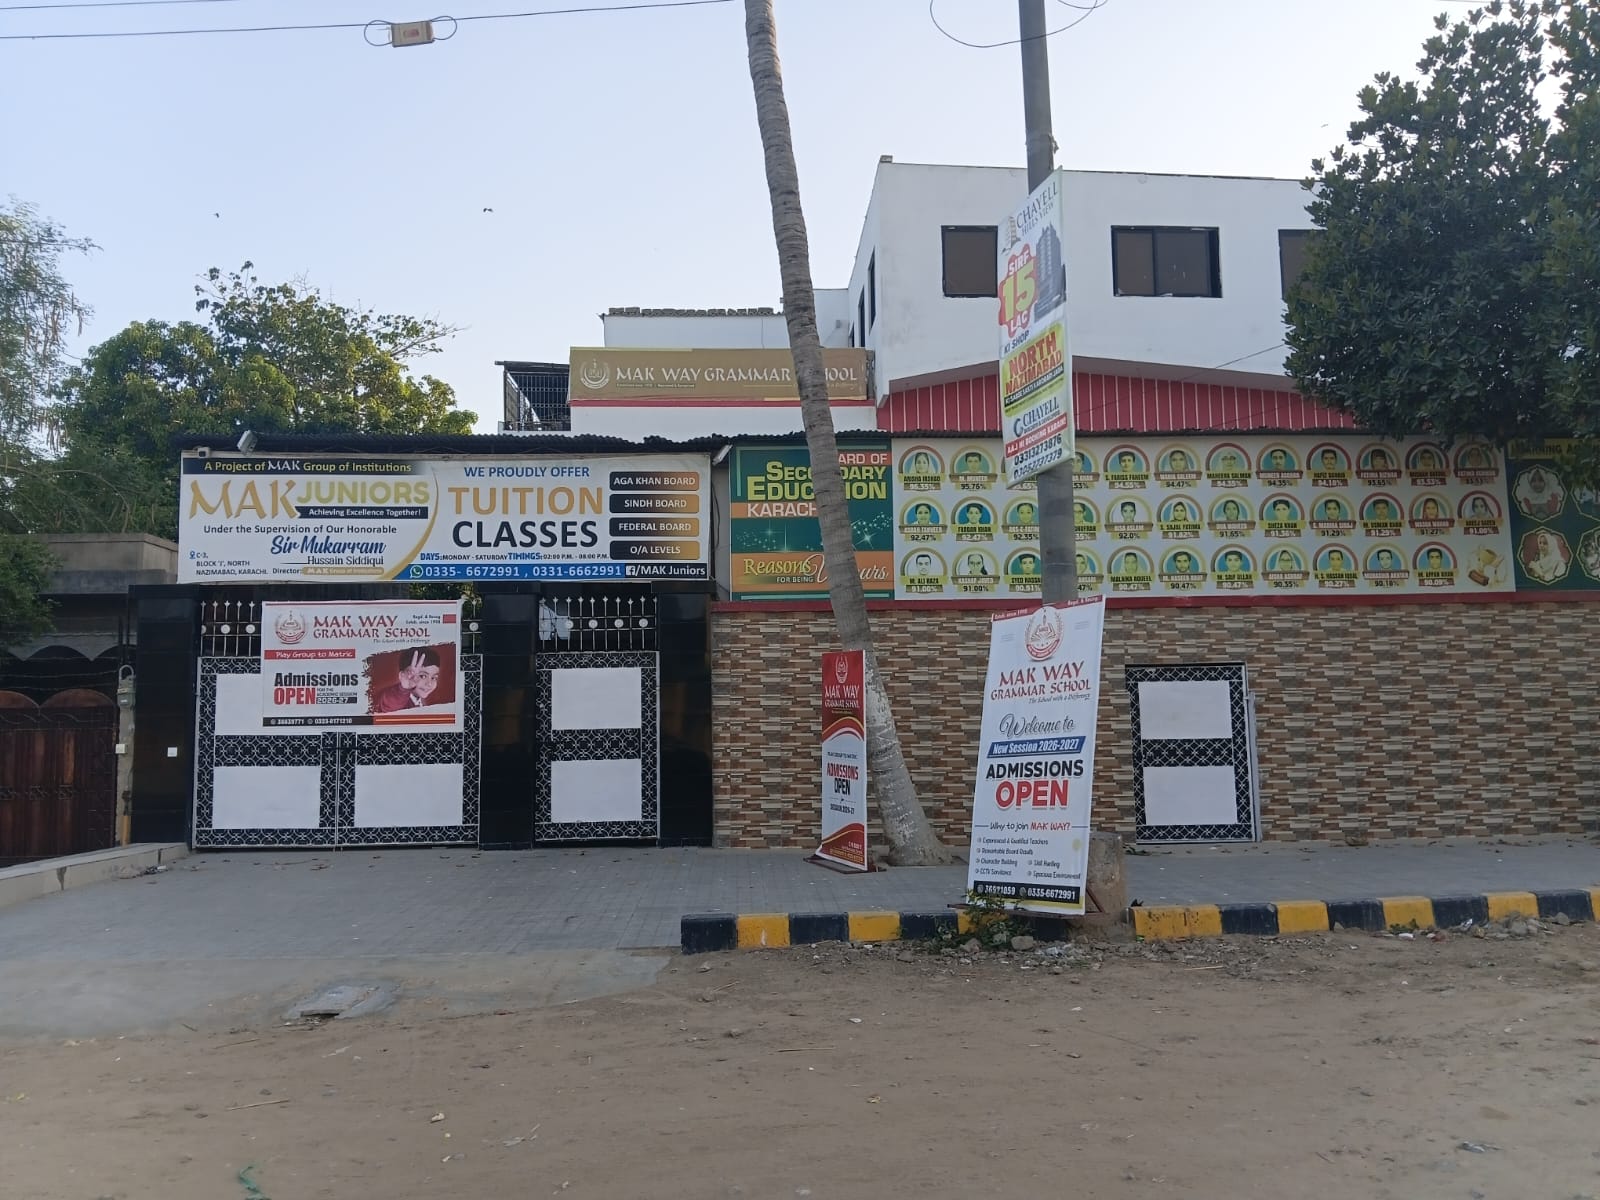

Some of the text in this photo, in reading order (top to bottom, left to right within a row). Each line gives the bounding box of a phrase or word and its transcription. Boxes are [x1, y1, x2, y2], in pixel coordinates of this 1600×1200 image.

[1017, 182, 1058, 228] CHAYELL
[1008, 251, 1030, 275] SIRF
[1003, 259, 1035, 320] 15
[1010, 311, 1028, 332] LAC
[1004, 330, 1029, 354] KI SHOP
[1009, 331, 1056, 378] NORTH
[616, 367, 655, 381] MAK
[662, 368, 700, 381] WAY
[704, 368, 791, 382] GRAMMAR
[1006, 350, 1062, 395] NAZIMABAD
[1023, 397, 1059, 426] CHAYELL
[204, 460, 412, 474] A Project of MAK Group of Institutions
[871, 454, 887, 464] OF
[464, 466, 590, 477] WE PROUDLY OFFER
[189, 480, 430, 519] MAK JUNIORS
[448, 487, 602, 515] TUITION
[624, 499, 687, 508] SINDH BOARD
[309, 508, 421, 517] Achieving Excellence Together!
[204, 525, 397, 536] Under the Supervision of Our Honorable
[452, 521, 598, 548] CLASSES
[659, 523, 691, 531] BOARD
[270, 535, 387, 555] Sir Mukarram
[630, 546, 648, 554] O/A
[307, 556, 384, 567] Hussain Siddiqui
[669, 565, 705, 575] Juniors
[744, 559, 811, 576] Reasons
[425, 566, 622, 576] 0335- 6672991 0331-6662991
[314, 615, 398, 628] MAK WAY
[313, 627, 430, 638] GRAMMAR SCHOOL
[274, 672, 358, 687] Admissions
[999, 660, 1085, 687] MAK WAY
[273, 688, 316, 705] OPEN
[825, 685, 859, 698] MAK WAY
[991, 679, 1091, 700] GRAMMAR SCHOOL
[1000, 713, 1075, 738] Welcome to
[992, 738, 1079, 755] New Session 2026-2027
[827, 763, 858, 780] ADMISSIONS
[986, 760, 1084, 779] ADMISSIONS
[834, 778, 850, 796] OPEN
[995, 780, 1069, 808] OPEN
[990, 823, 1005, 831] Why
[1028, 887, 1076, 900] 0335-6672991
